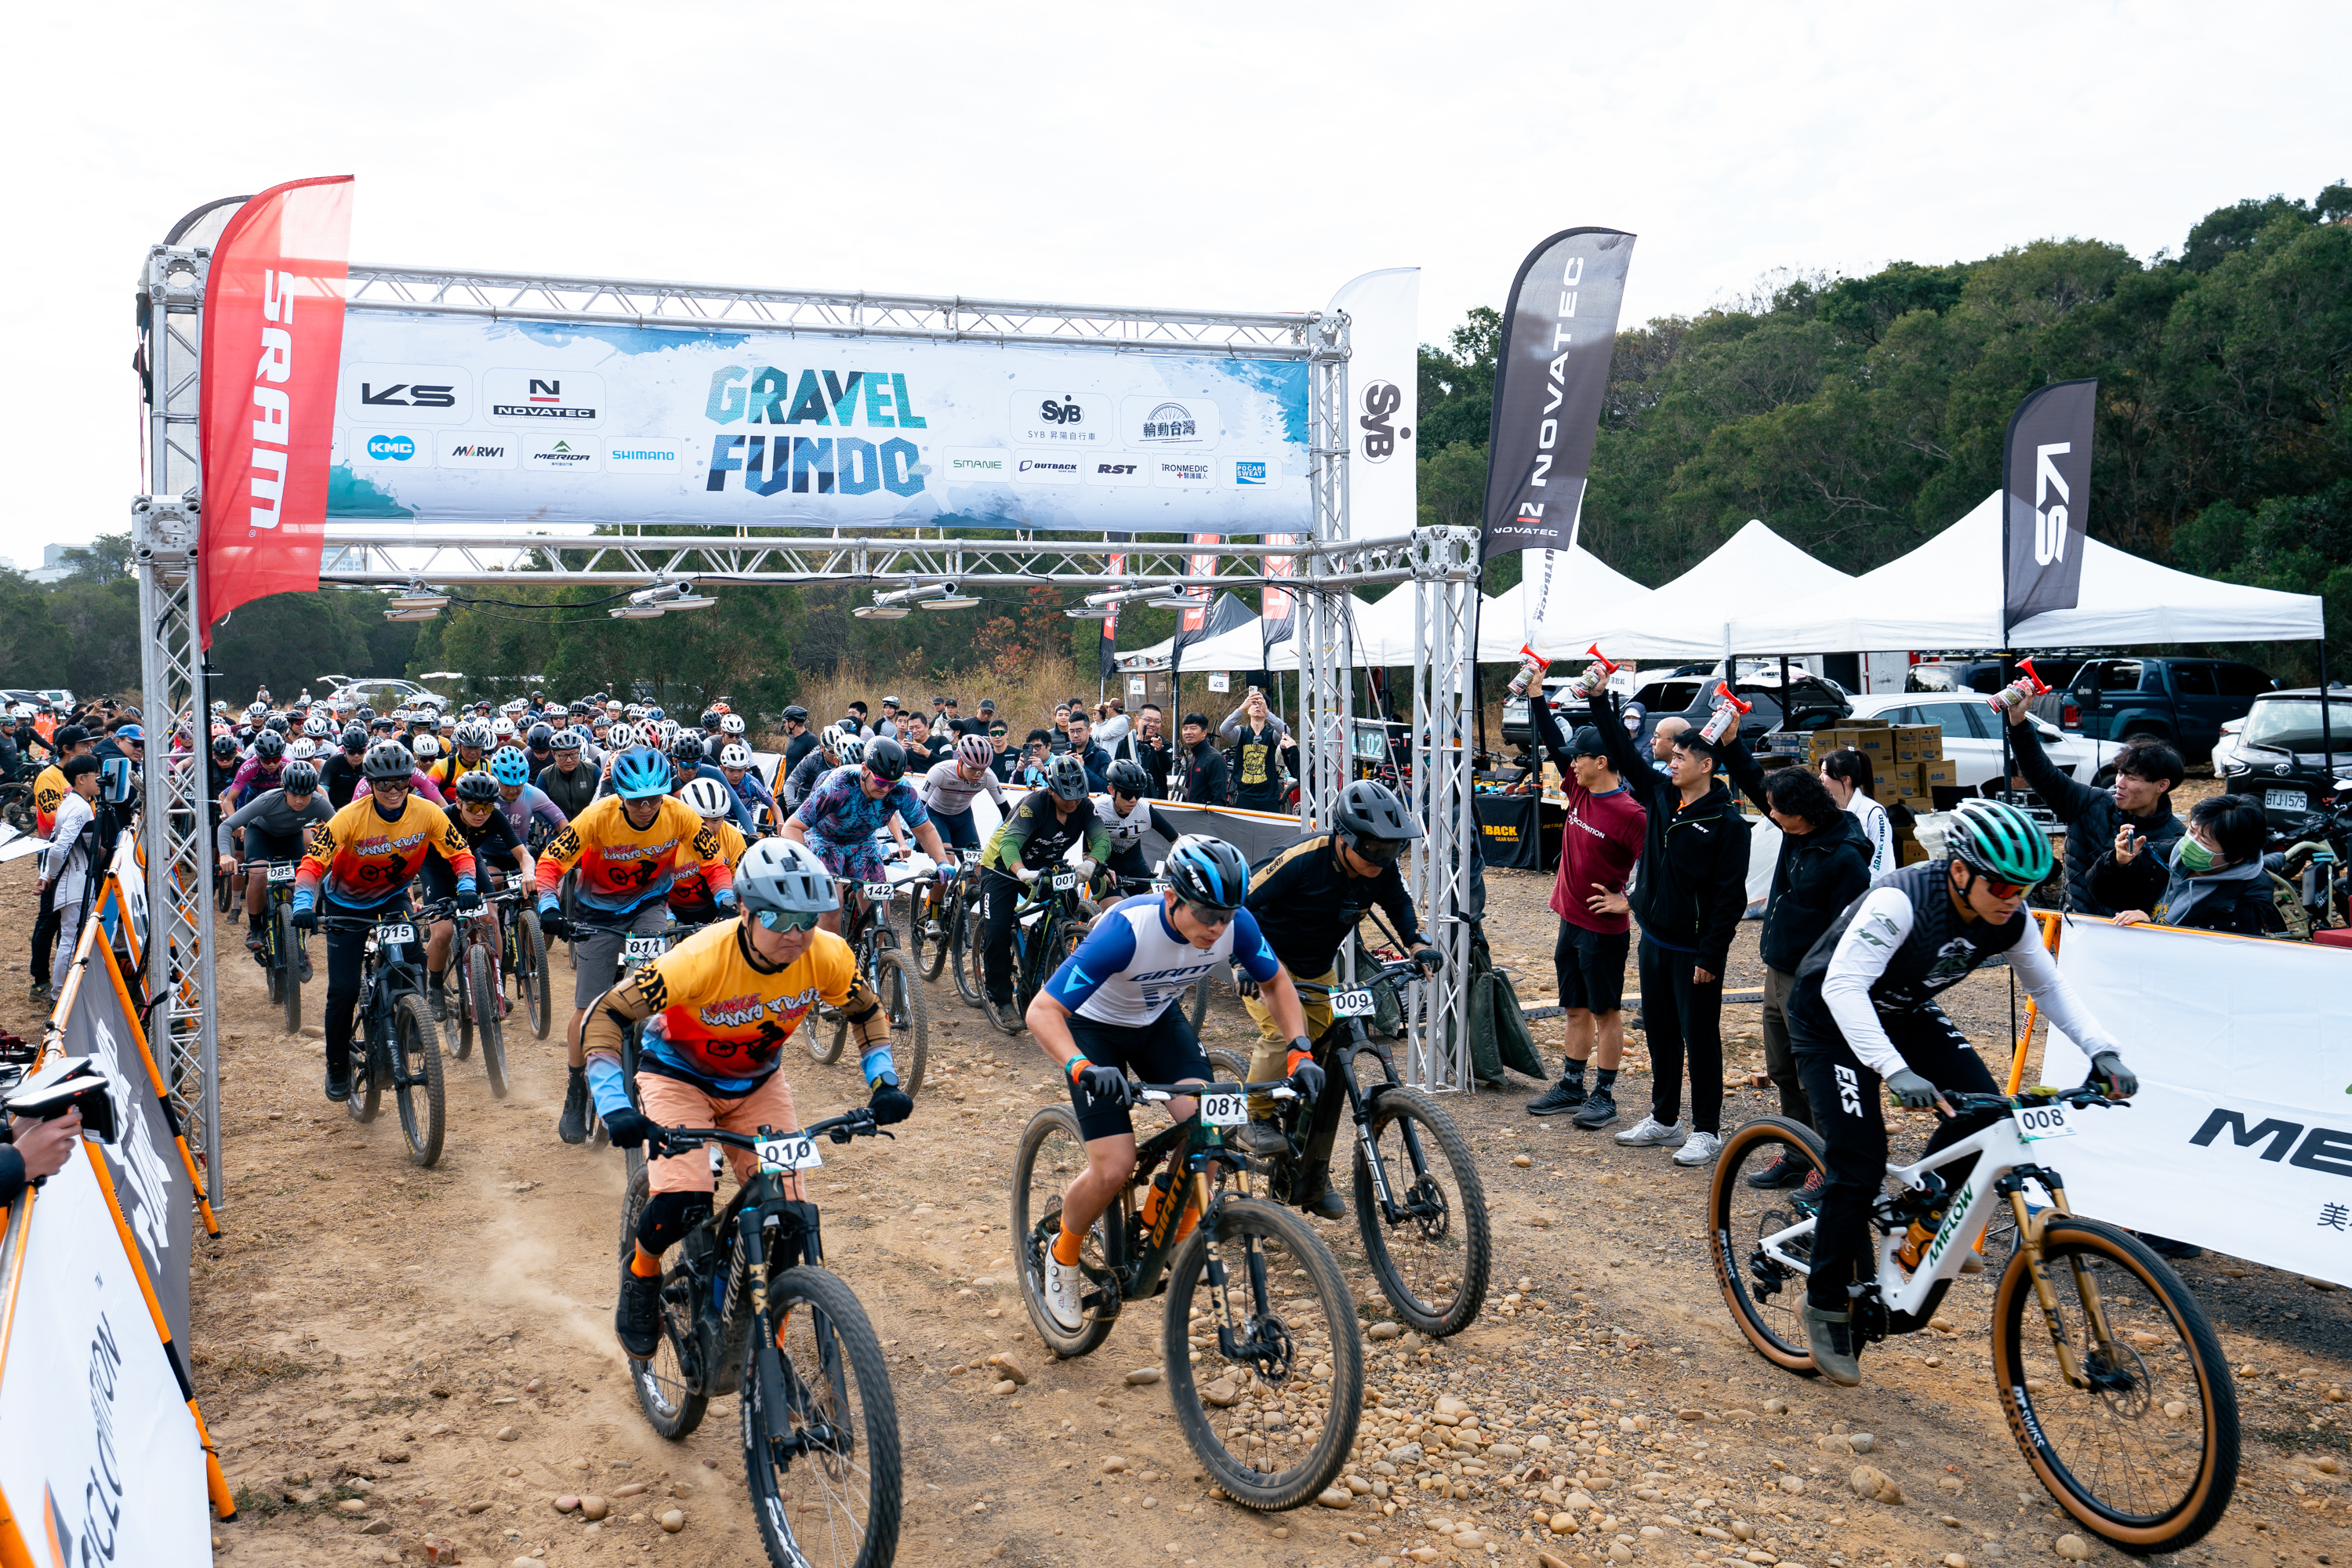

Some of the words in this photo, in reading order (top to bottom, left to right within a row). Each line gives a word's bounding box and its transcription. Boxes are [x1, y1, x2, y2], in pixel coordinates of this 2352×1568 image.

[1531, 256, 1584, 487] NOVATEC
[361, 383, 456, 407] KS
[530, 379, 560, 395] N
[250, 268, 295, 530] SRAM
[705, 365, 927, 429] GRAVEL
[498, 406, 590, 417] NOVATEC
[1051, 431, 1096, 441] 昇陽自行車
[1143, 420, 1196, 438] 輪動台灣
[371, 441, 412, 454] KMC
[452, 444, 504, 458] MARWI
[612, 450, 675, 461] SHIMANO
[706, 434, 926, 497] FUNDO
[953, 459, 1002, 470] SMANIE
[1098, 464, 1138, 474] RST
[1519, 503, 1544, 517] N
[2034, 441, 2071, 567] KS
[1492, 527, 1559, 537] NOVATEC
[2267, 793, 2307, 808] BTJ-1575
[1692, 822, 1709, 834] RST
[270, 869, 291, 877] 085
[1266, 855, 1285, 874] LEATT
[1056, 874, 1074, 886] 001
[1185, 864, 1208, 894] MET
[867, 885, 891, 896] 142
[381, 926, 410, 939] 015
[1127, 961, 1220, 982] GIANT
[1336, 993, 1369, 1010] 009
[1206, 1098, 1242, 1117] 081
[2023, 1109, 2065, 1131] 008
[765, 1140, 811, 1163] 010
[1152, 1157, 1187, 1250] GIANT
[1929, 1182, 1974, 1269] AMFLOW
[2318, 1201, 2352, 1232] 美
[749, 1264, 771, 1315] FOX
[1210, 1284, 1232, 1330] FOX
[2044, 1306, 2068, 1346] FOX
[2021, 1409, 2045, 1448] SWISS
